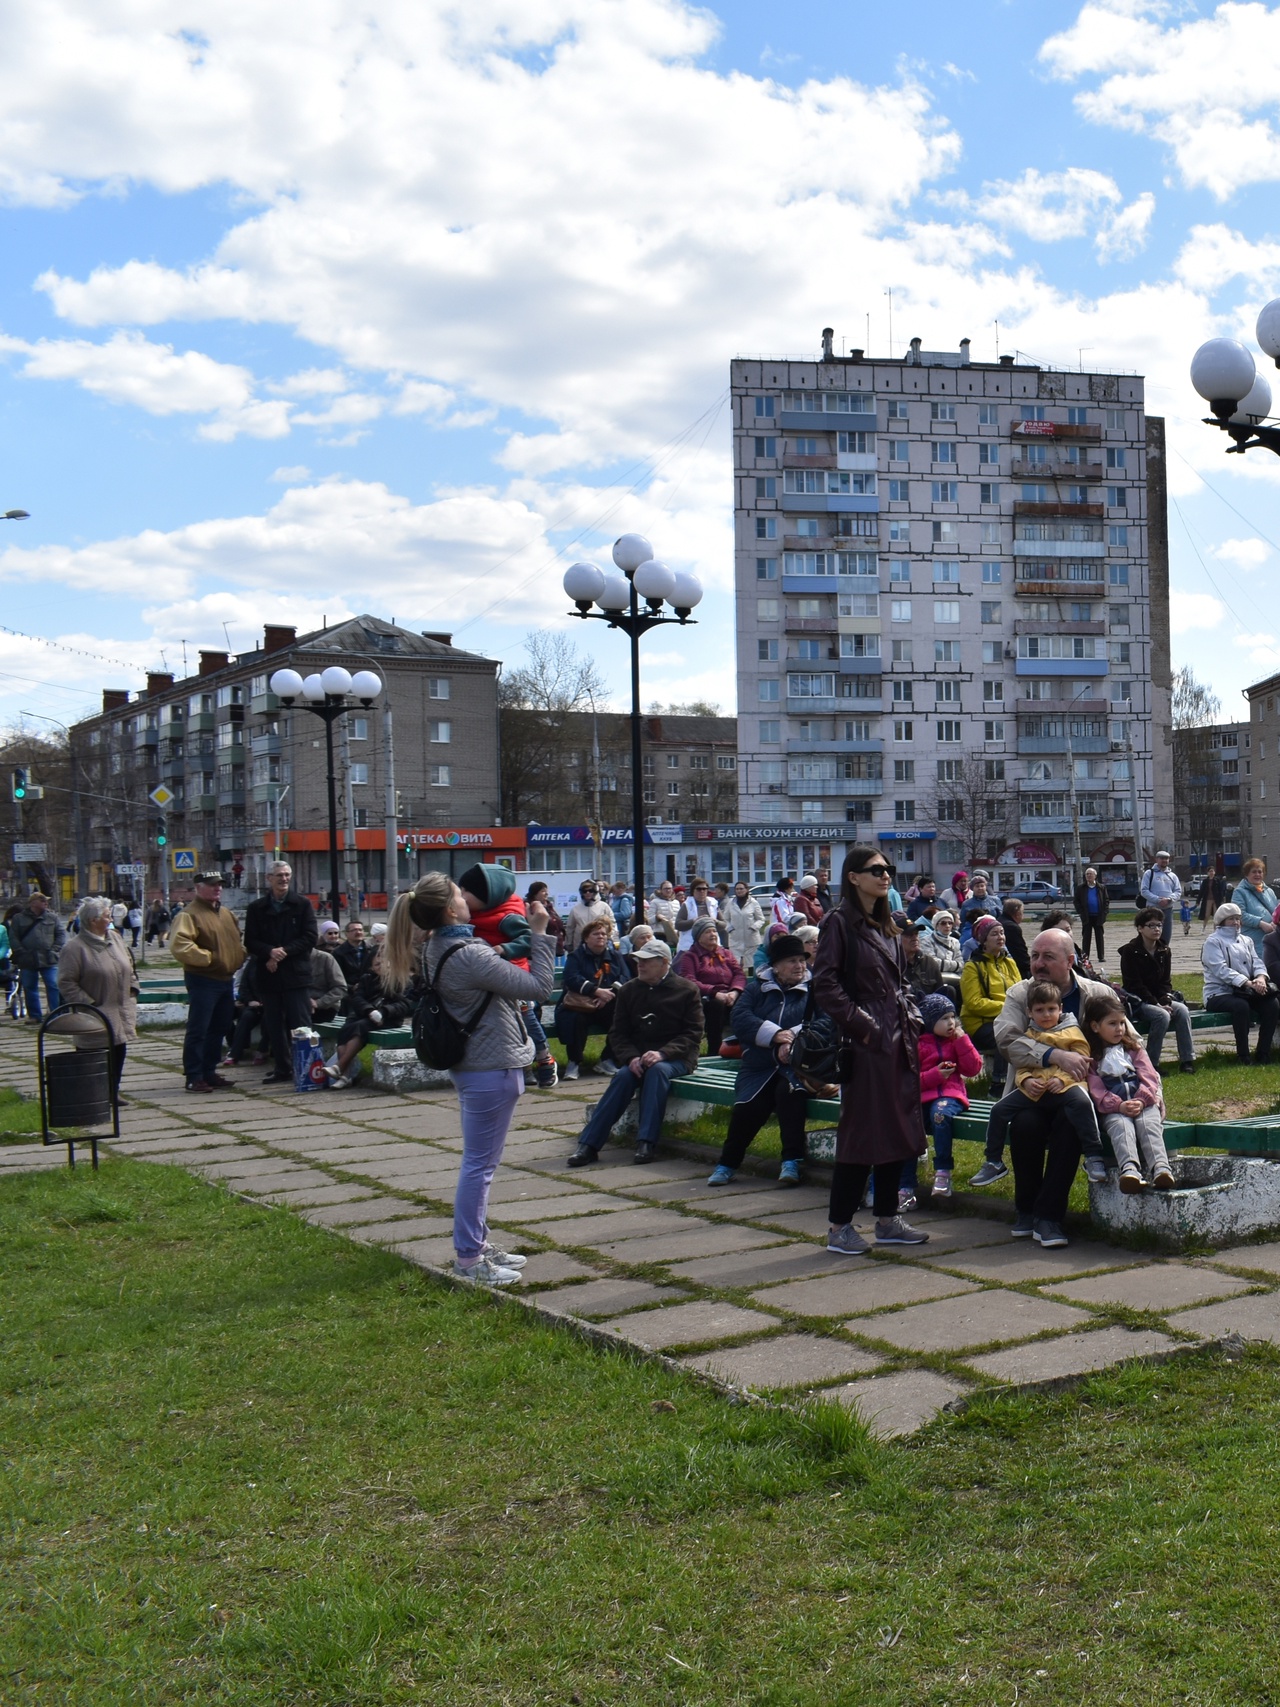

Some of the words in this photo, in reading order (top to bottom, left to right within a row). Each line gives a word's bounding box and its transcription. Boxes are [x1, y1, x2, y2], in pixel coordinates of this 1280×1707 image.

[395, 834, 445, 844] АПТЕКА
[461, 833, 493, 843] ВИТА
[531, 833, 571, 841] АПТЕКА
[585, 829, 633, 840] АПРЕЛ
[717, 829, 751, 838] БАНК
[755, 829, 791, 838] ХОУМ
[795, 828, 846, 838] КРЕДИТ
